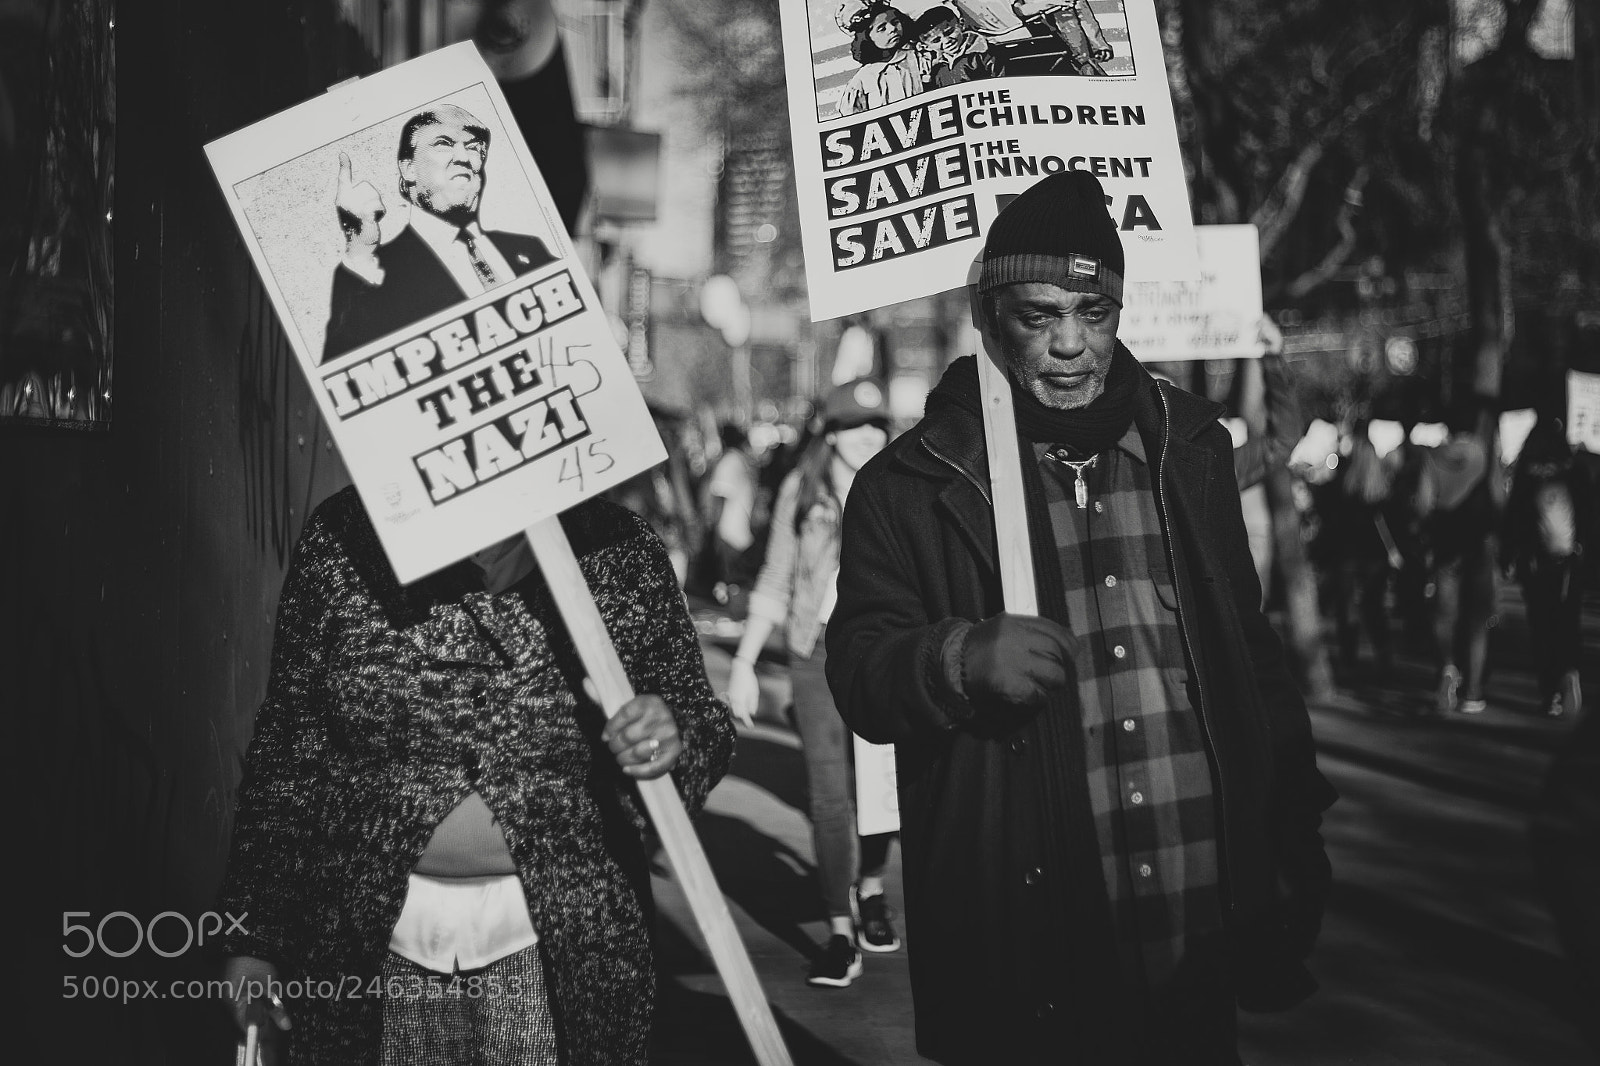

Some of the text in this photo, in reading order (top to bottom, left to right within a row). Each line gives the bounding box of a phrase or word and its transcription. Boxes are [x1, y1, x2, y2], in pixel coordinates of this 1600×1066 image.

[962, 89, 1012, 108] THE
[965, 105, 1146, 129] CHILDREN
[825, 99, 958, 168] SAVE
[970, 139, 1021, 157] THE
[830, 148, 965, 217] SAVE
[974, 156, 1152, 180] INNOCENT
[836, 198, 973, 267] SAVE
[322, 272, 583, 417] IMPEACH
[538, 336, 602, 399] 45
[417, 348, 544, 430] THE
[416, 389, 588, 502] NAZI
[558, 438, 615, 492] 45
